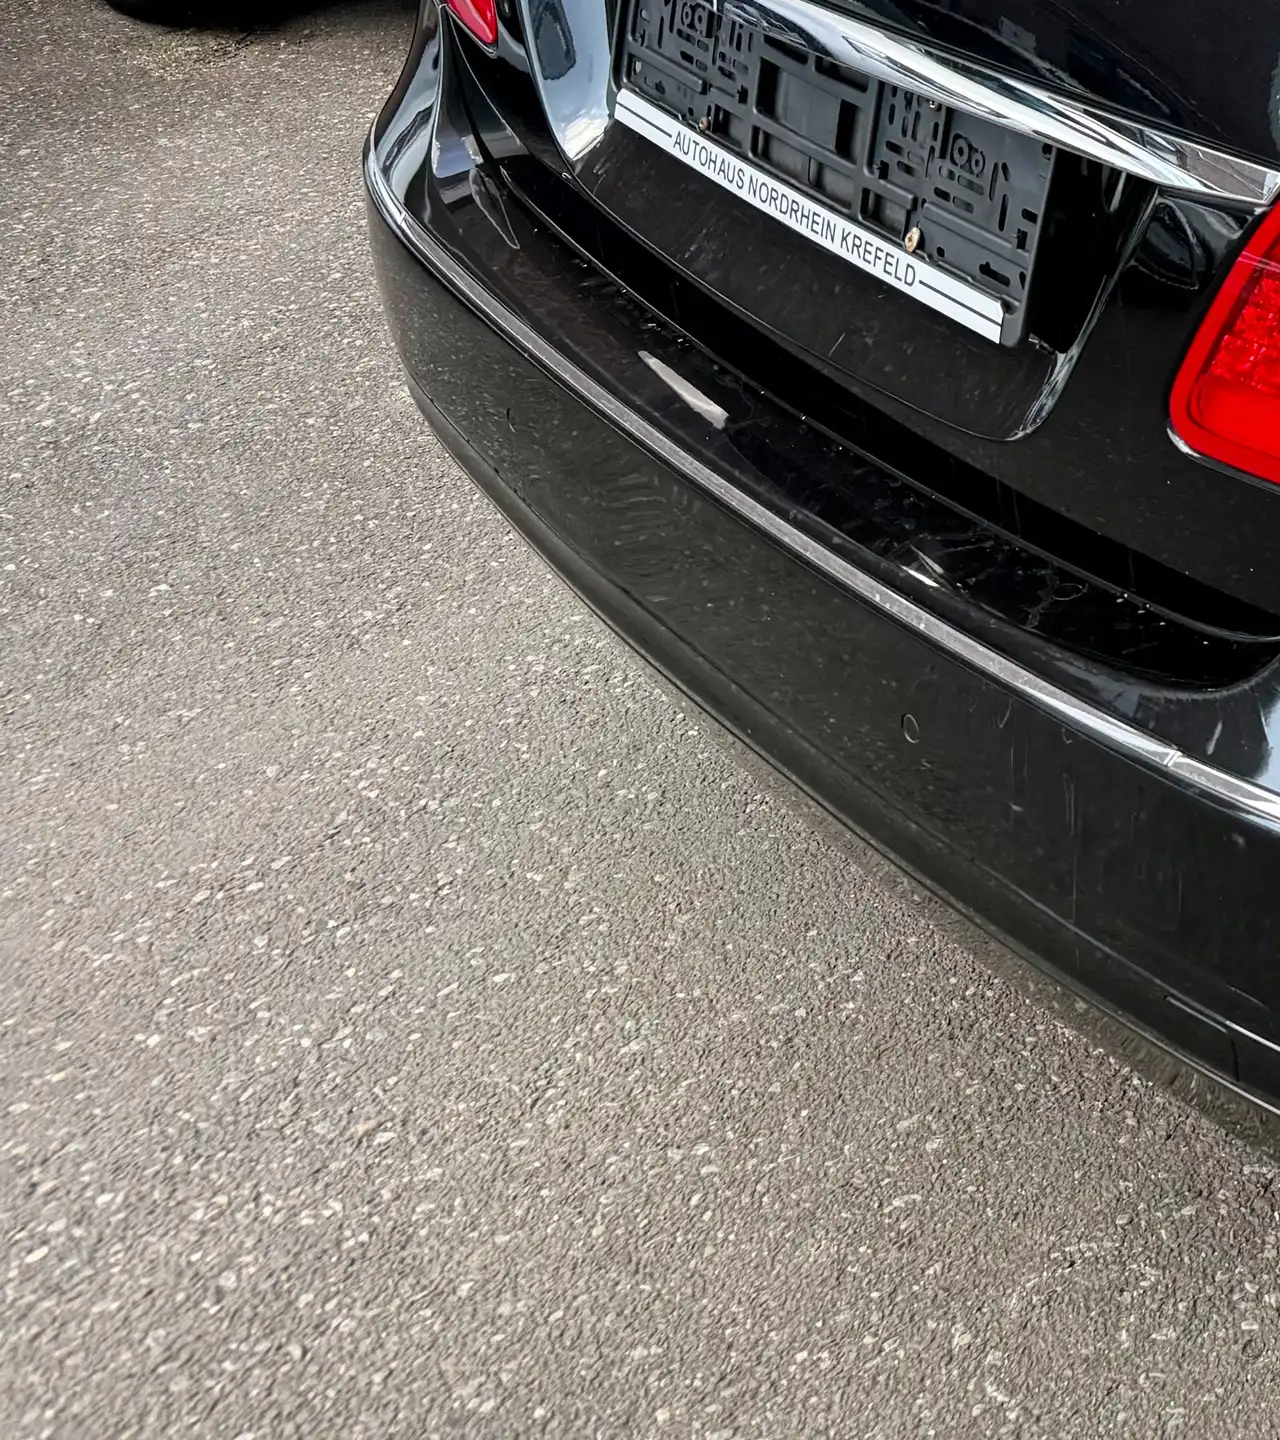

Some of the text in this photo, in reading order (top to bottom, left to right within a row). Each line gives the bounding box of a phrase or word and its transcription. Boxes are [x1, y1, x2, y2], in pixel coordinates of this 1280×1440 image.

[673, 130, 917, 288] AUTOHAUS NORDRHEIN KREFELD
